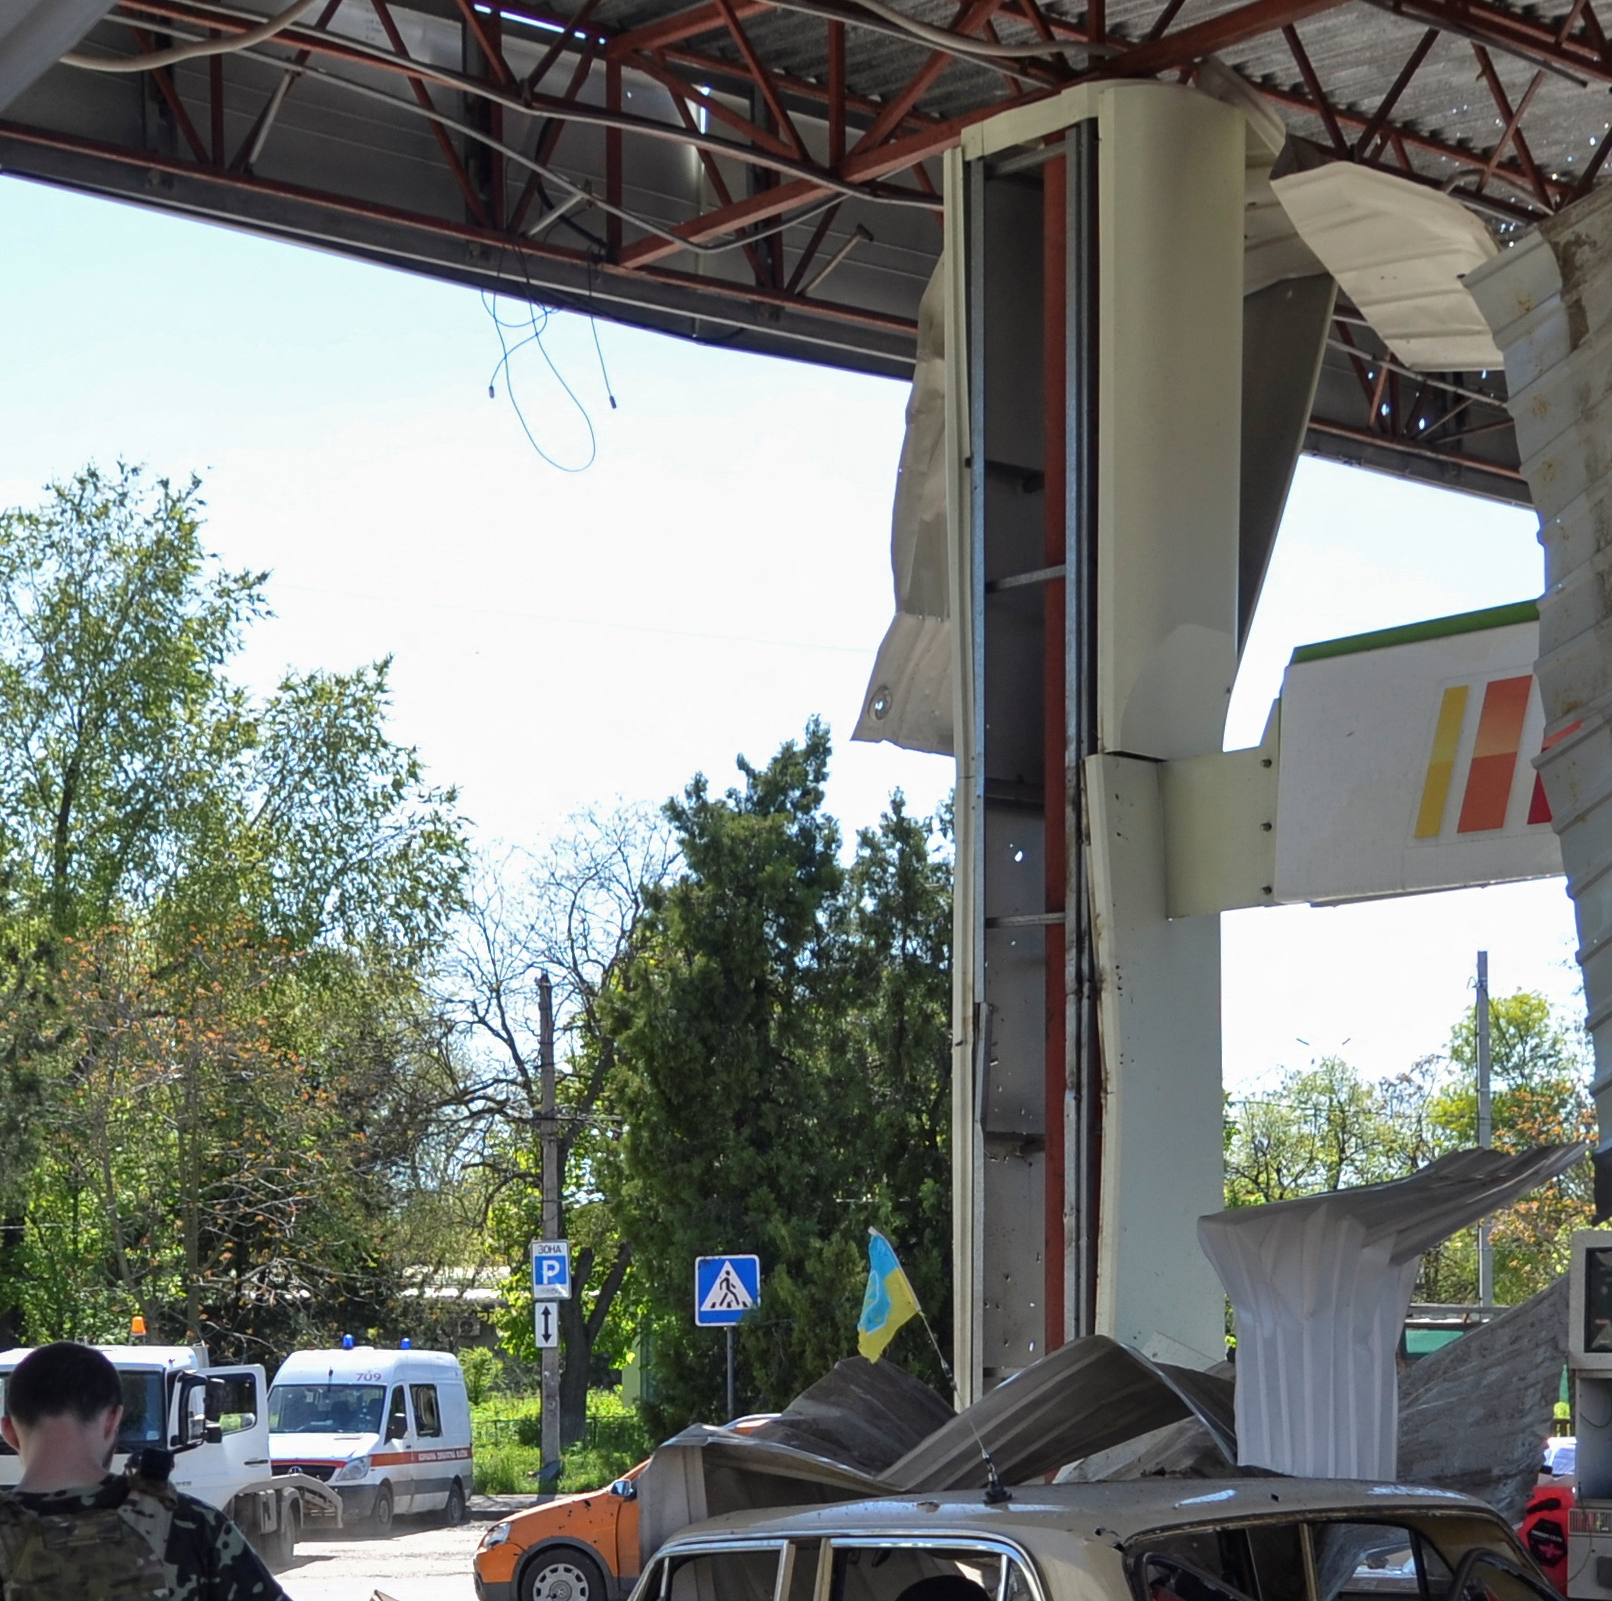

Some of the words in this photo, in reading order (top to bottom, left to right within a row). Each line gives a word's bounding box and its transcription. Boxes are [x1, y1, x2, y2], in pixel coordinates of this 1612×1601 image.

[538, 1244, 562, 1255] ЗОНА
[542, 1259, 560, 1285] P
[355, 1372, 382, 1382] 709
